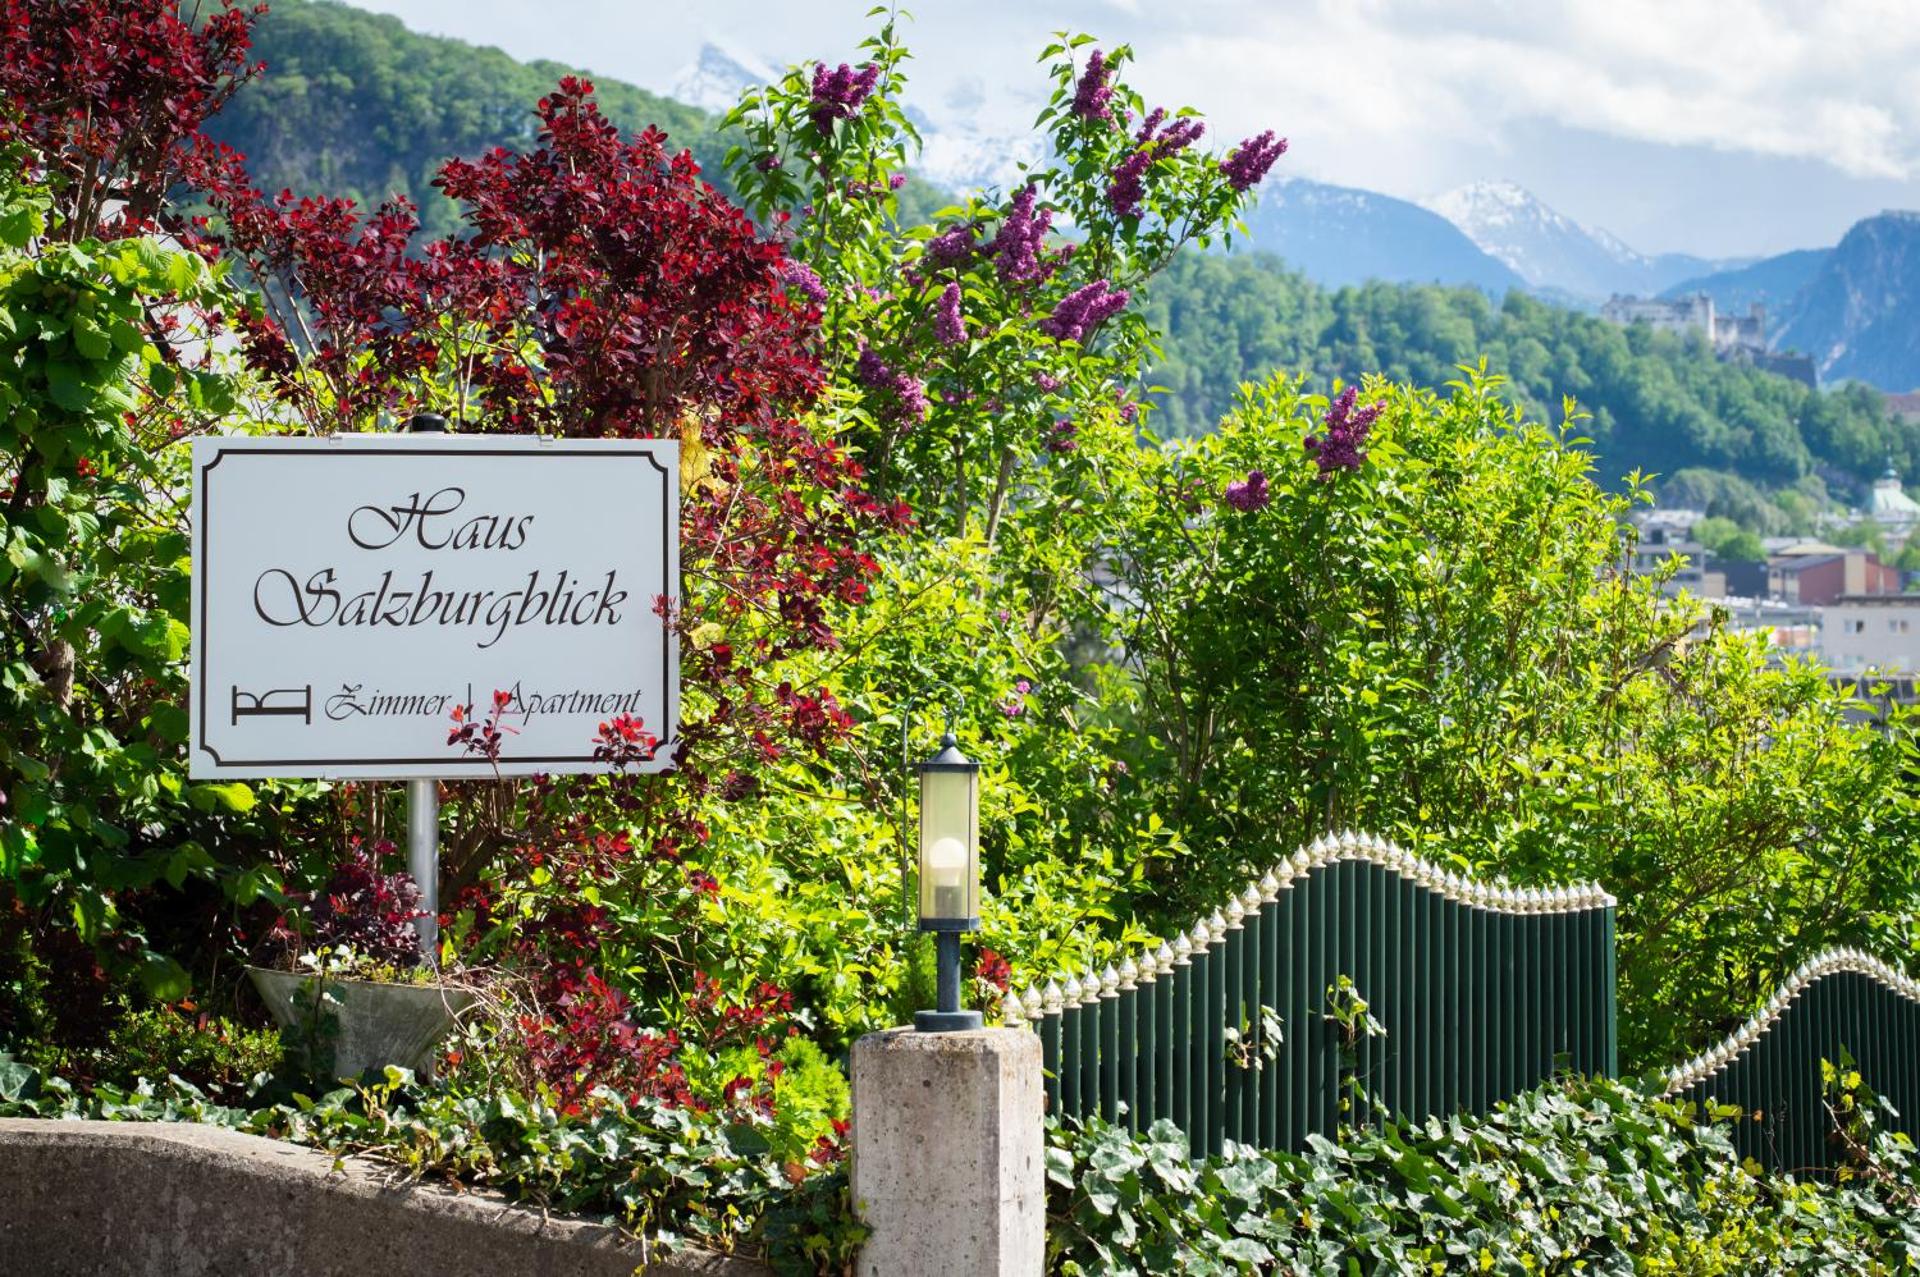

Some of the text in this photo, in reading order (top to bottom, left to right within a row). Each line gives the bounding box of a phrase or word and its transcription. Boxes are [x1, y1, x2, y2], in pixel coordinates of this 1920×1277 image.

[347, 486, 535, 551] Haus
[253, 567, 629, 649] Salzburgblick
[324, 683, 452, 721] Zimmer
[500, 680, 643, 727] Apartment
